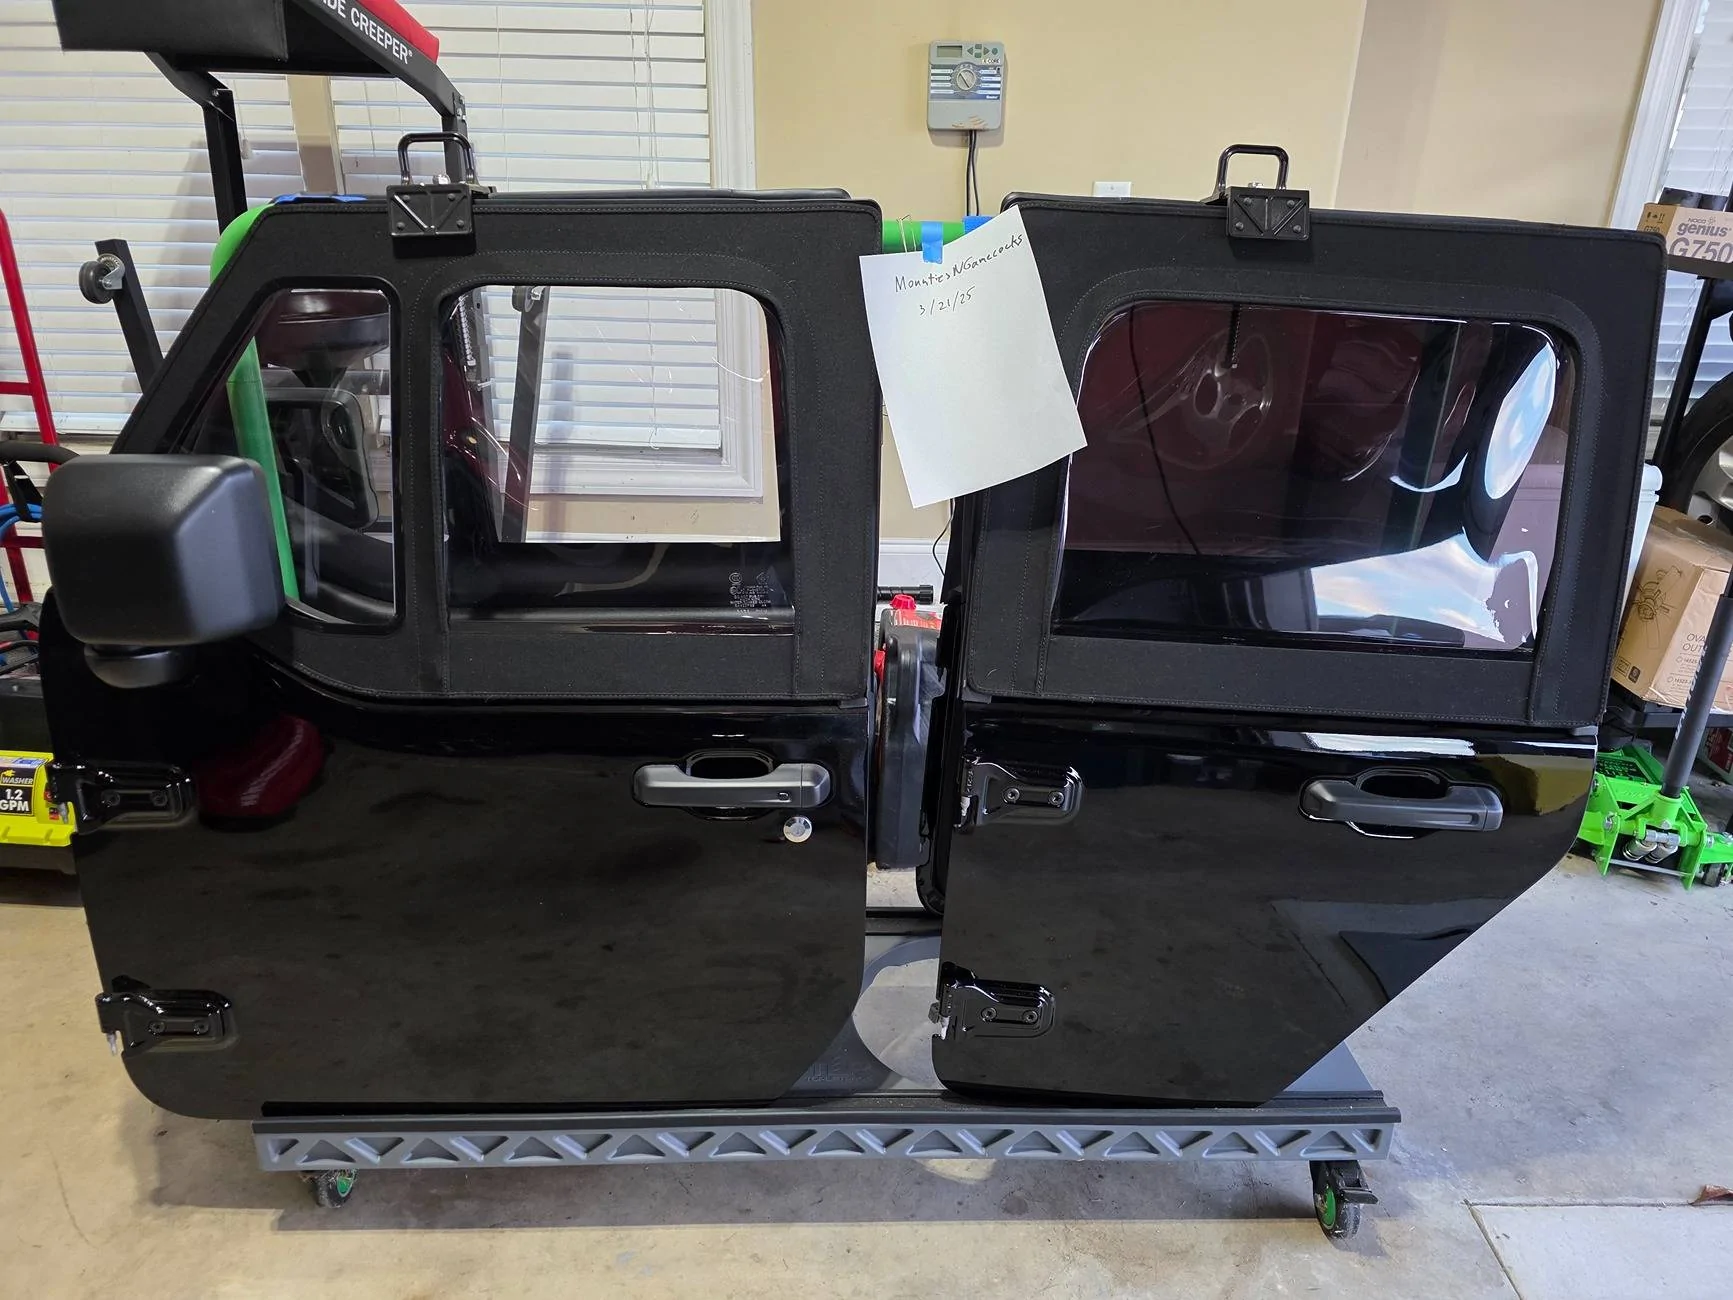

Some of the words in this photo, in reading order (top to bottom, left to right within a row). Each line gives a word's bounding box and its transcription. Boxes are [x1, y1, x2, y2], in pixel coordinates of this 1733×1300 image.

[1676, 223, 1728, 237] genius
[1670, 237, 1733, 262] G750
[919, 286, 976, 316] 3/21/25
[5, 788, 23, 800] 1.2
[0, 800, 30, 812] GPM
